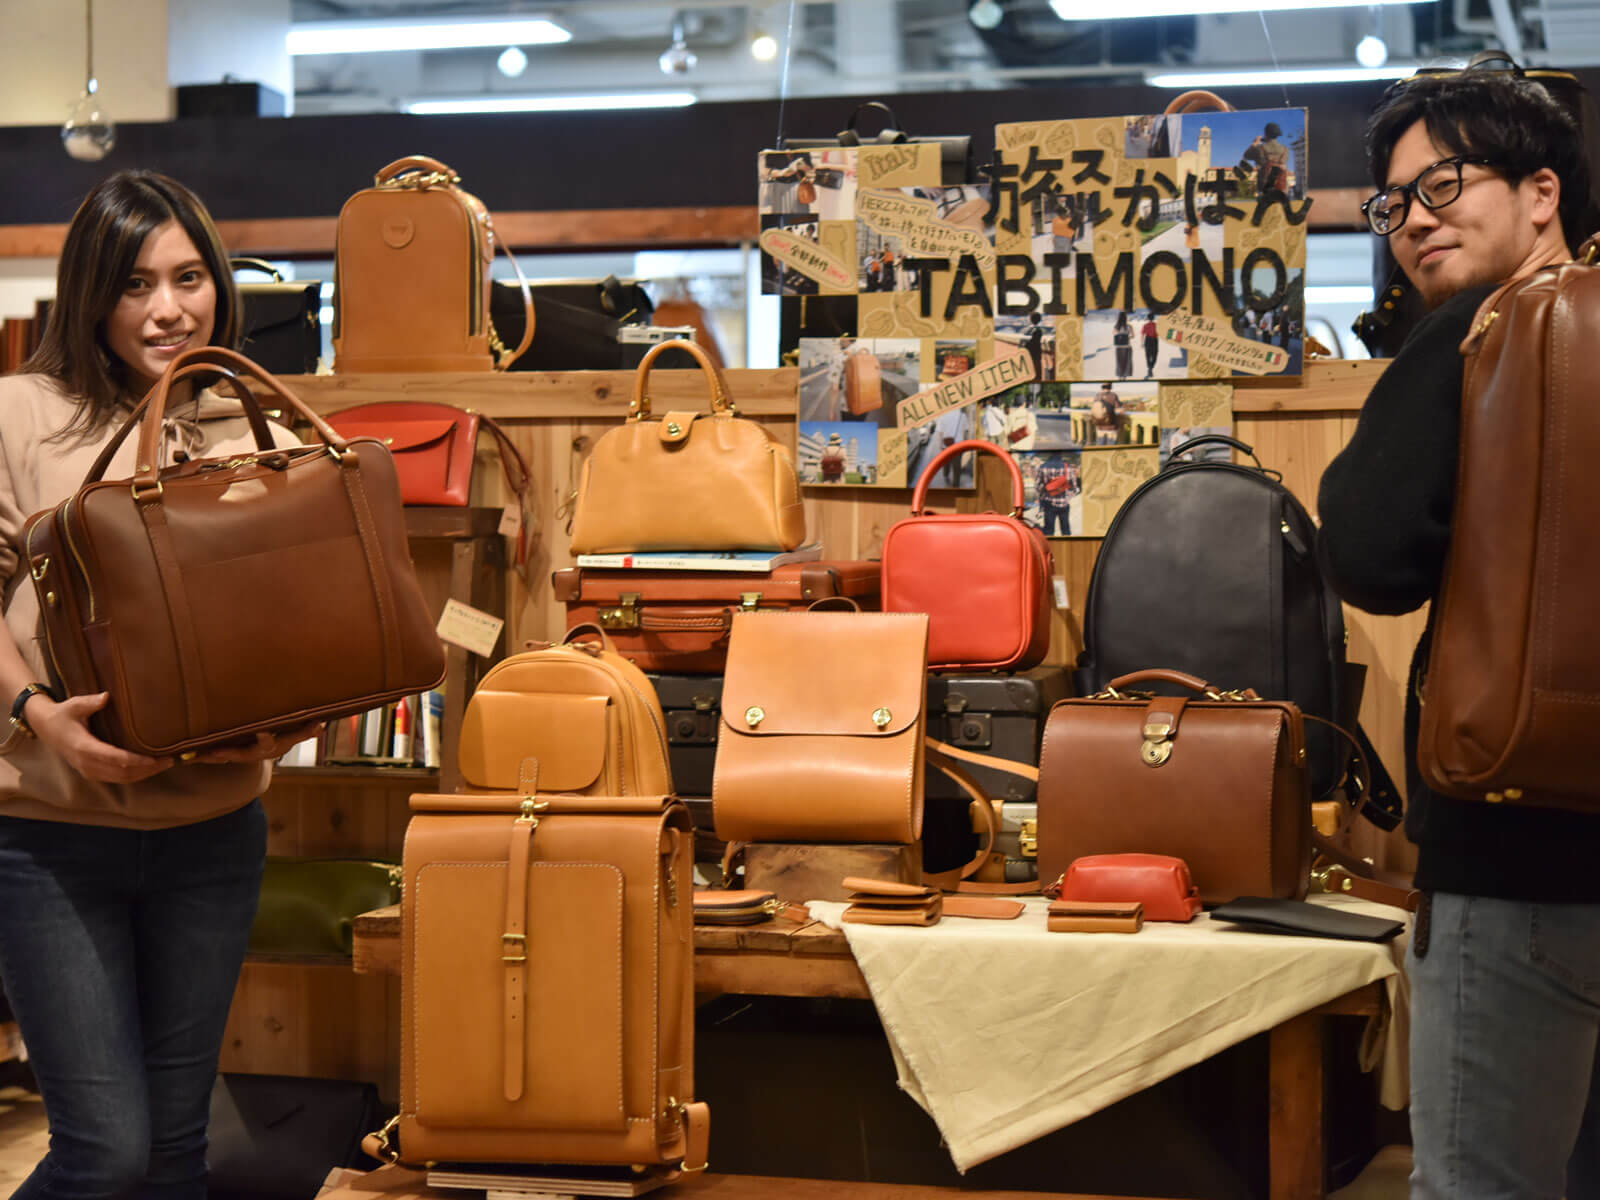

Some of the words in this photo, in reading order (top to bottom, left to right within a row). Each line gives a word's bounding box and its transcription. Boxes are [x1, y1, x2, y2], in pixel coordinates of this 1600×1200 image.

[863, 143, 920, 181] Italy
[901, 248, 1288, 321] TABIMONO
[902, 397, 934, 426] ALL
[934, 375, 973, 409] NEW
[979, 354, 1030, 391] ITEM
